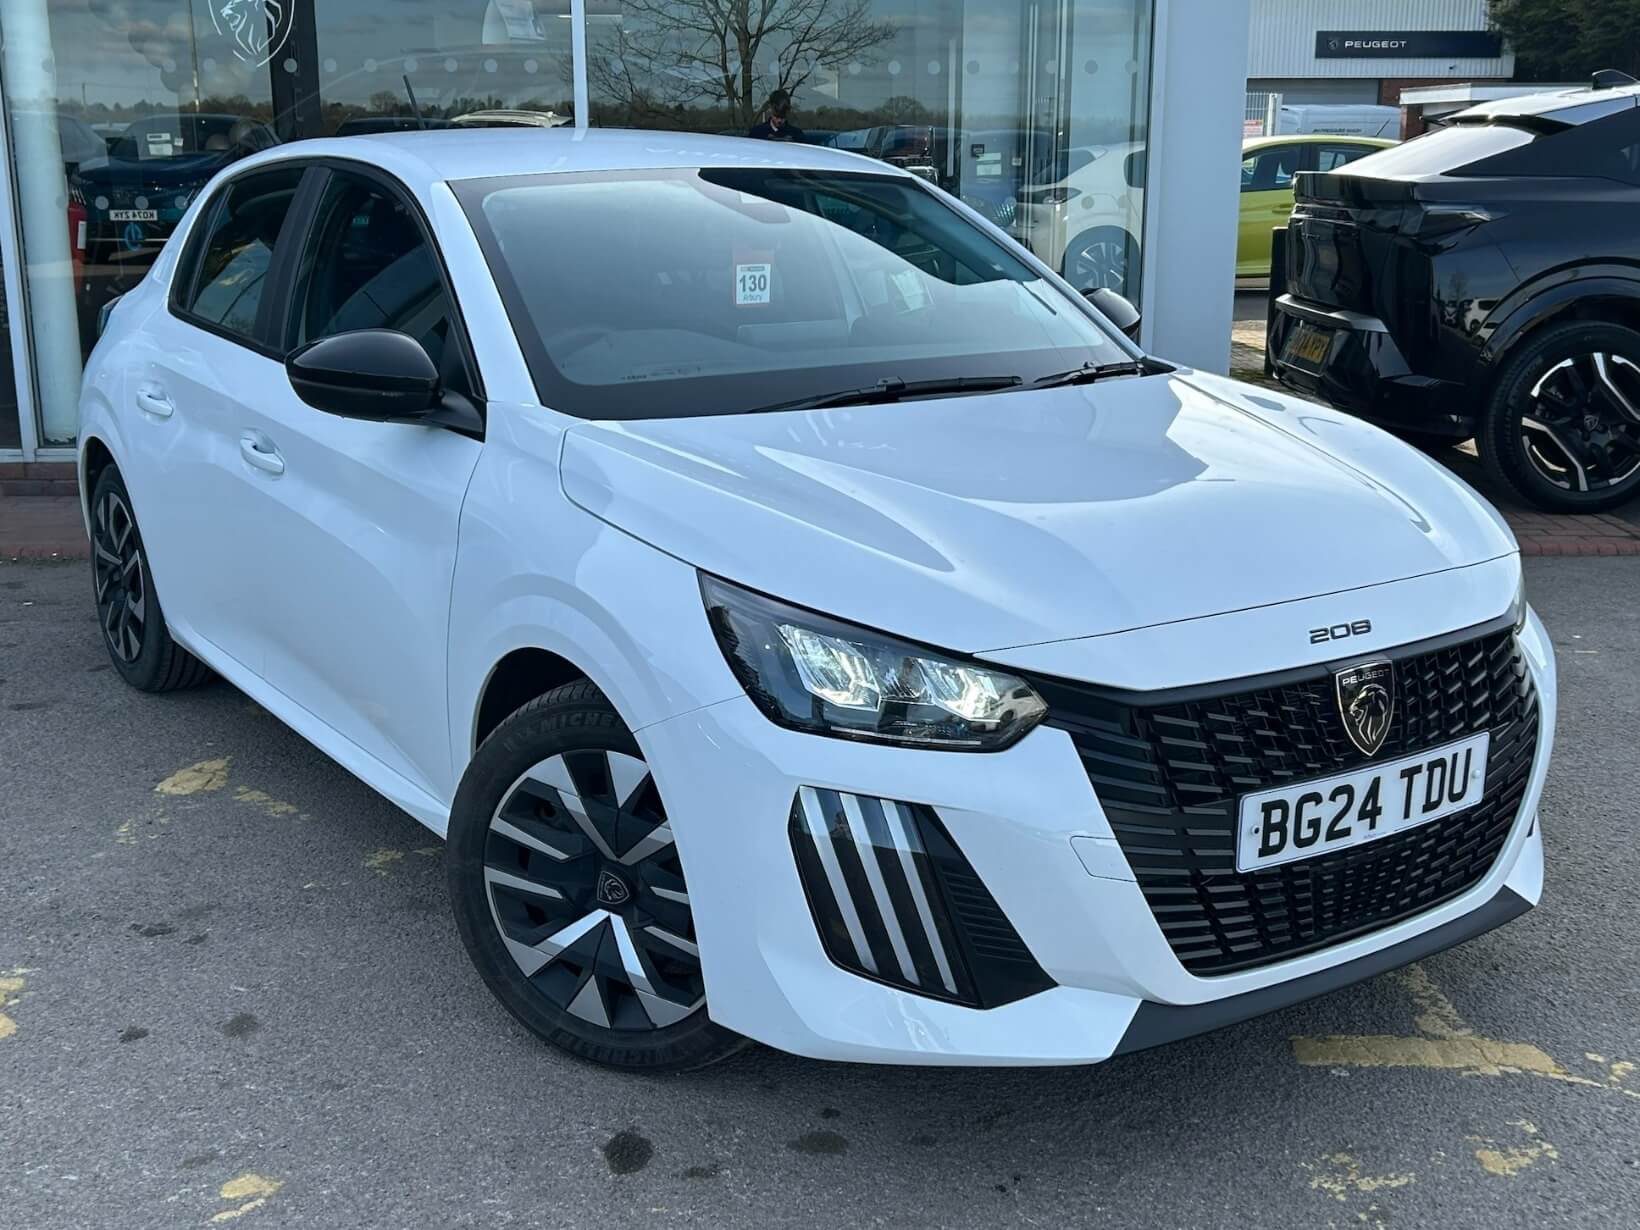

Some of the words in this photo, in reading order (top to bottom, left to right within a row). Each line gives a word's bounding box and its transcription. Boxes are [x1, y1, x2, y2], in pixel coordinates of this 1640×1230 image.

[1344, 40, 1407, 49] PEUGEOT
[739, 274, 767, 292] 130
[1309, 619, 1371, 644] 208
[1258, 775, 1382, 858] BG24
[1400, 748, 1472, 819] TDU
